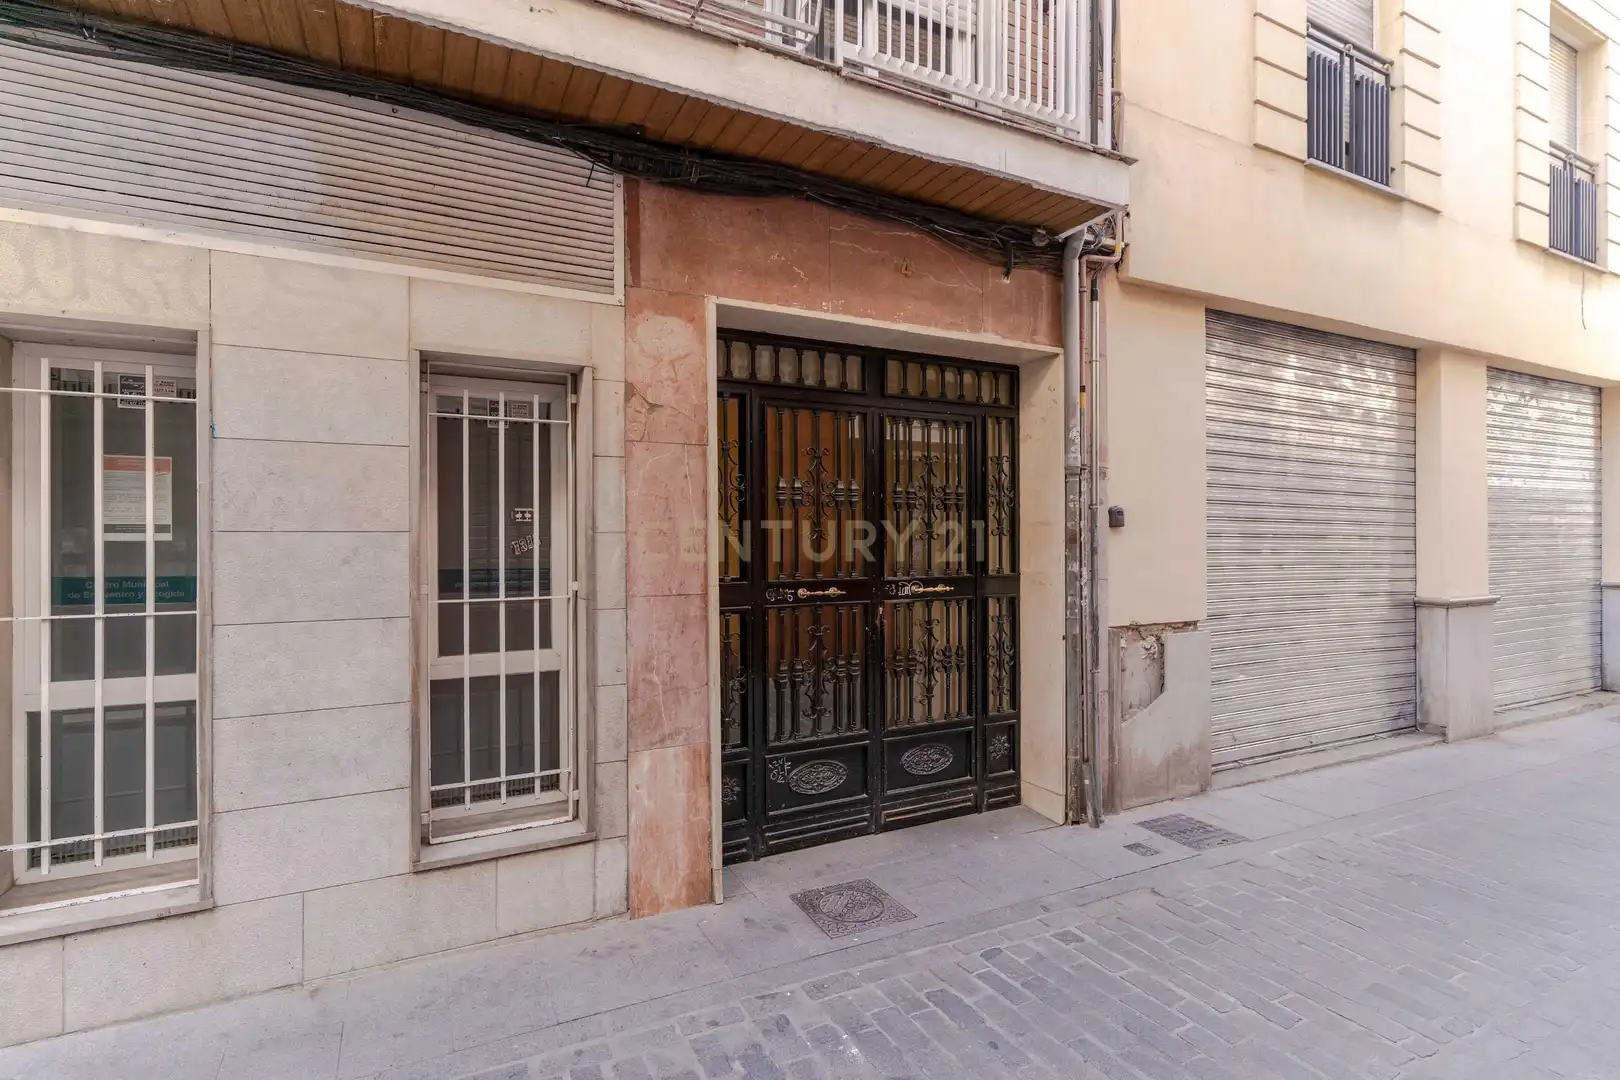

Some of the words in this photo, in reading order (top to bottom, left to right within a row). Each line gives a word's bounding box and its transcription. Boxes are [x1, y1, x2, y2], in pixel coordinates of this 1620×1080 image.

[85, 580, 120, 589] Ctro
[122, 580, 169, 588] Munipal
[67, 591, 81, 599] de
[136, 591, 144, 599] y
